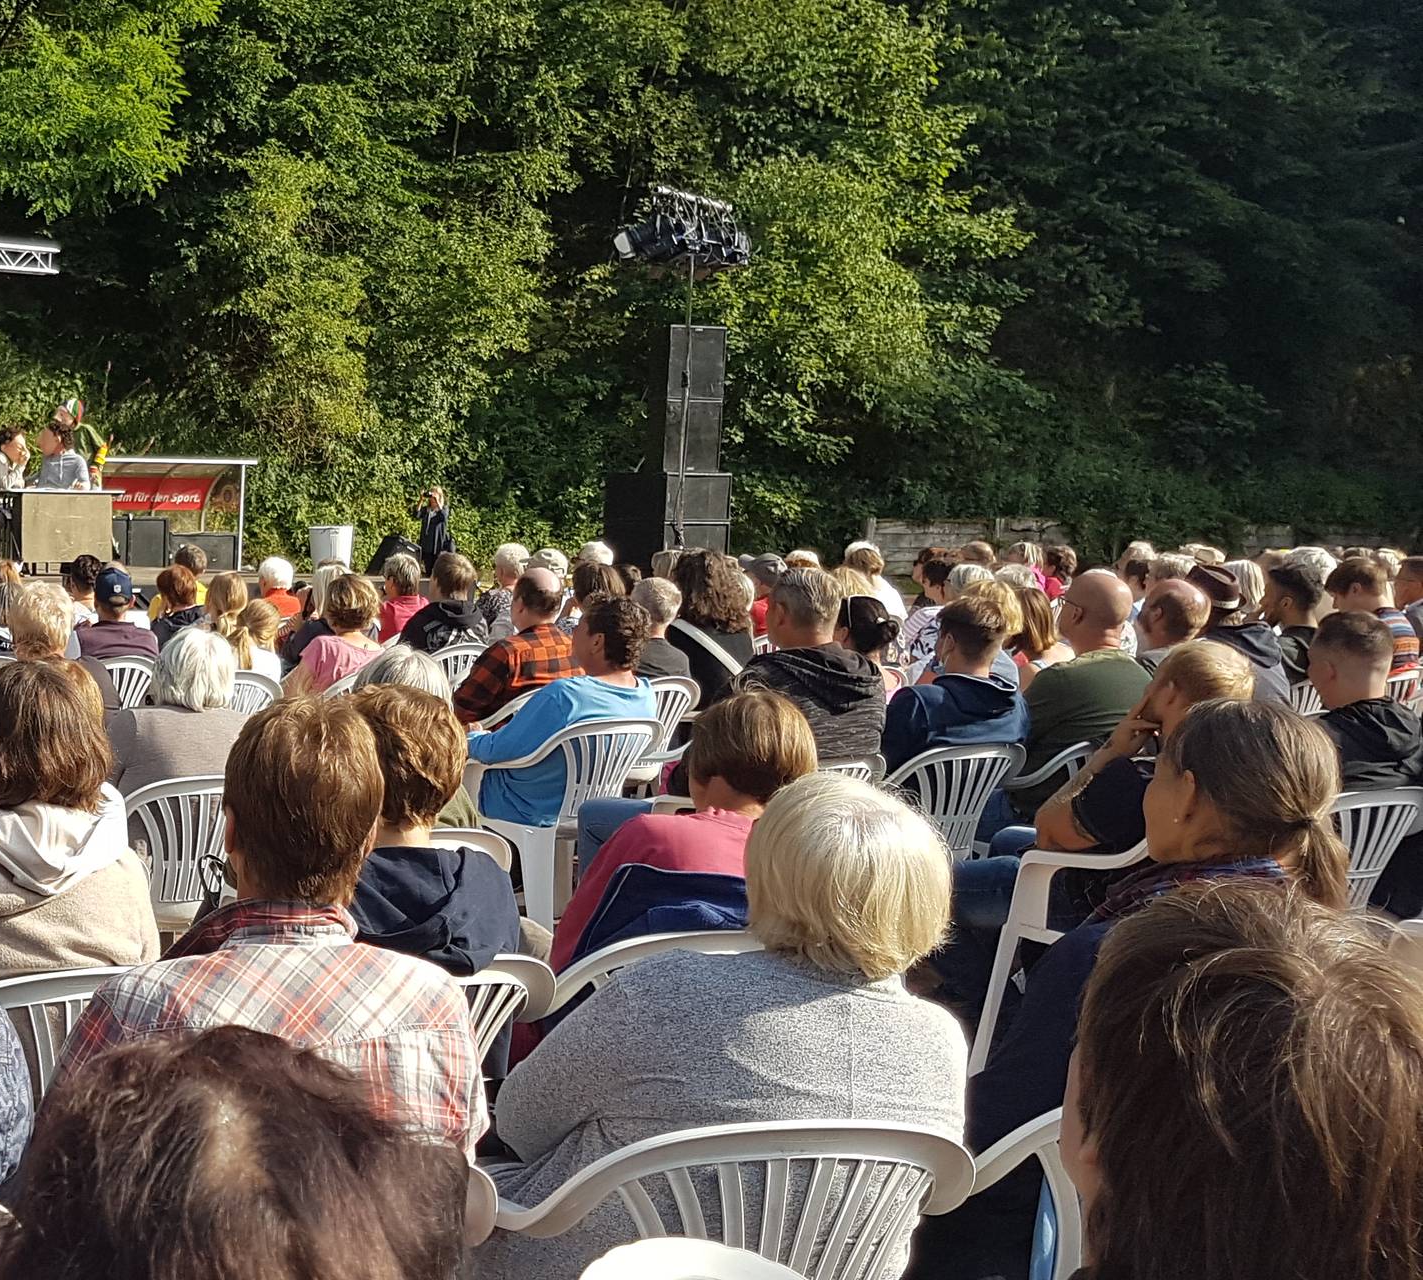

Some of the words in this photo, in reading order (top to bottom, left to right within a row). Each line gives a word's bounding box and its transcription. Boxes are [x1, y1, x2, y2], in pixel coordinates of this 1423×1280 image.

[133, 491, 150, 502] für
[151, 493, 169, 502] den
[170, 493, 201, 504] Sport.
